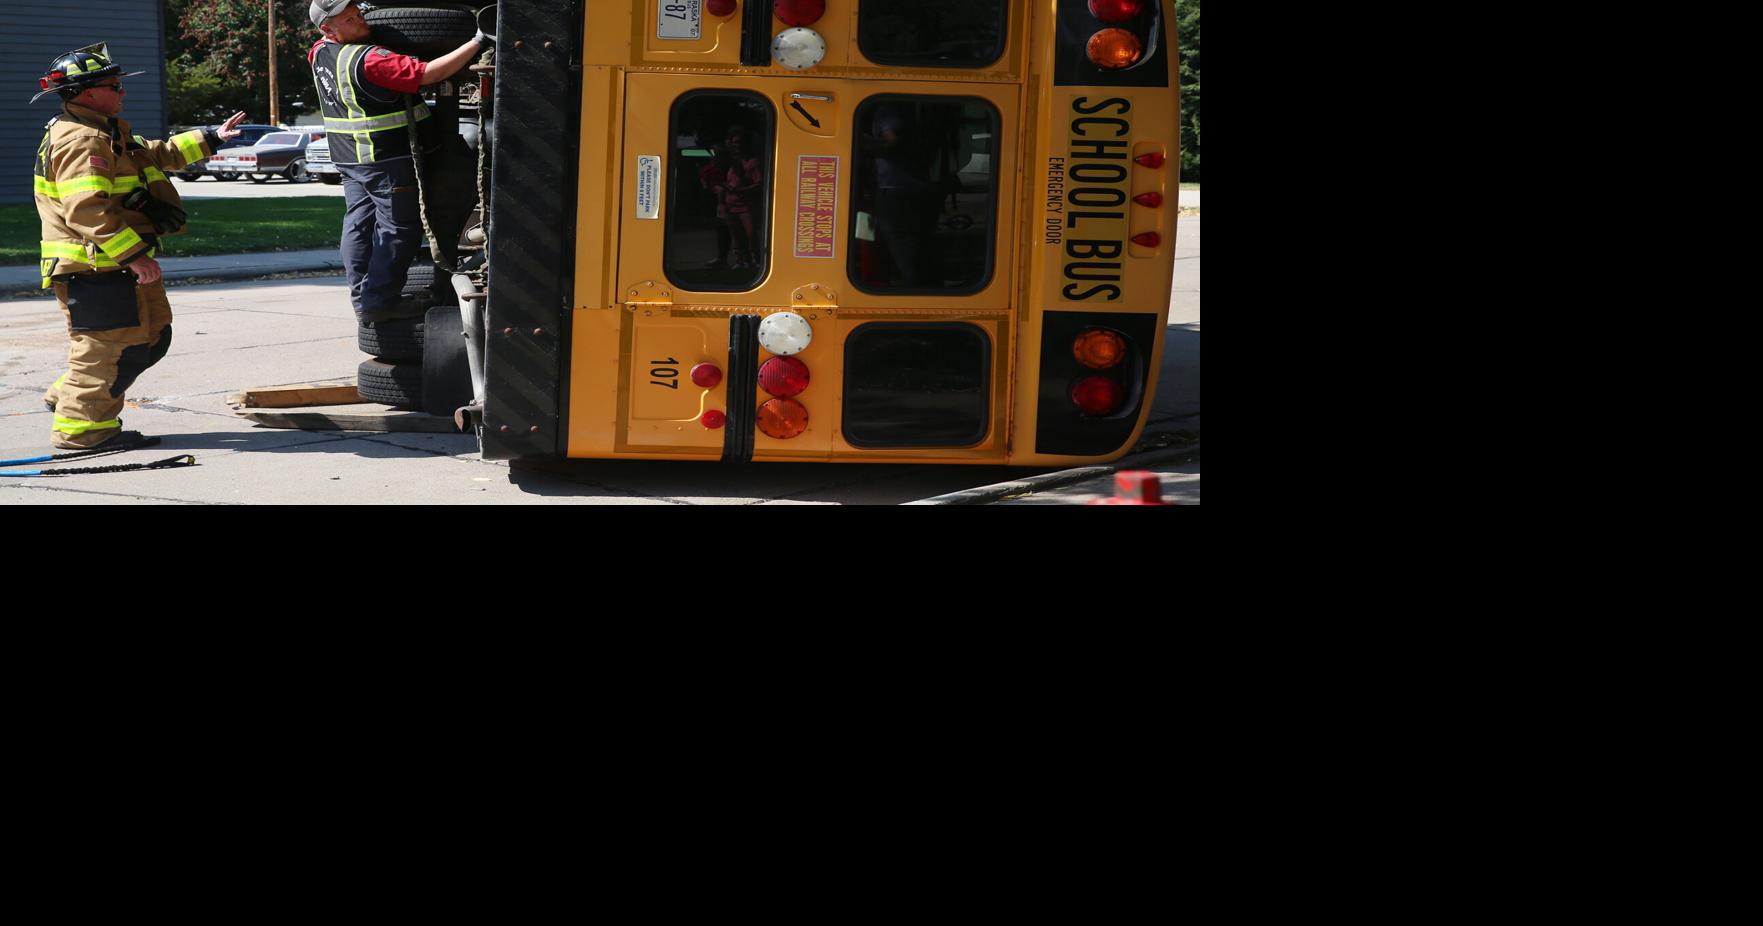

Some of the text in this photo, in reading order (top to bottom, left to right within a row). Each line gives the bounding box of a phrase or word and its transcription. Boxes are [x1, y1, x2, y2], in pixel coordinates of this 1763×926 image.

[797, 160, 818, 253] ALL RAILWAY CROSSINGS
[815, 160, 835, 252] THIS VEHICLE STOPS AT
[1045, 157, 1064, 244] EMERGENCY DOOR
[1062, 96, 1131, 300] SCHOOL BUS
[650, 357, 679, 389] 107
